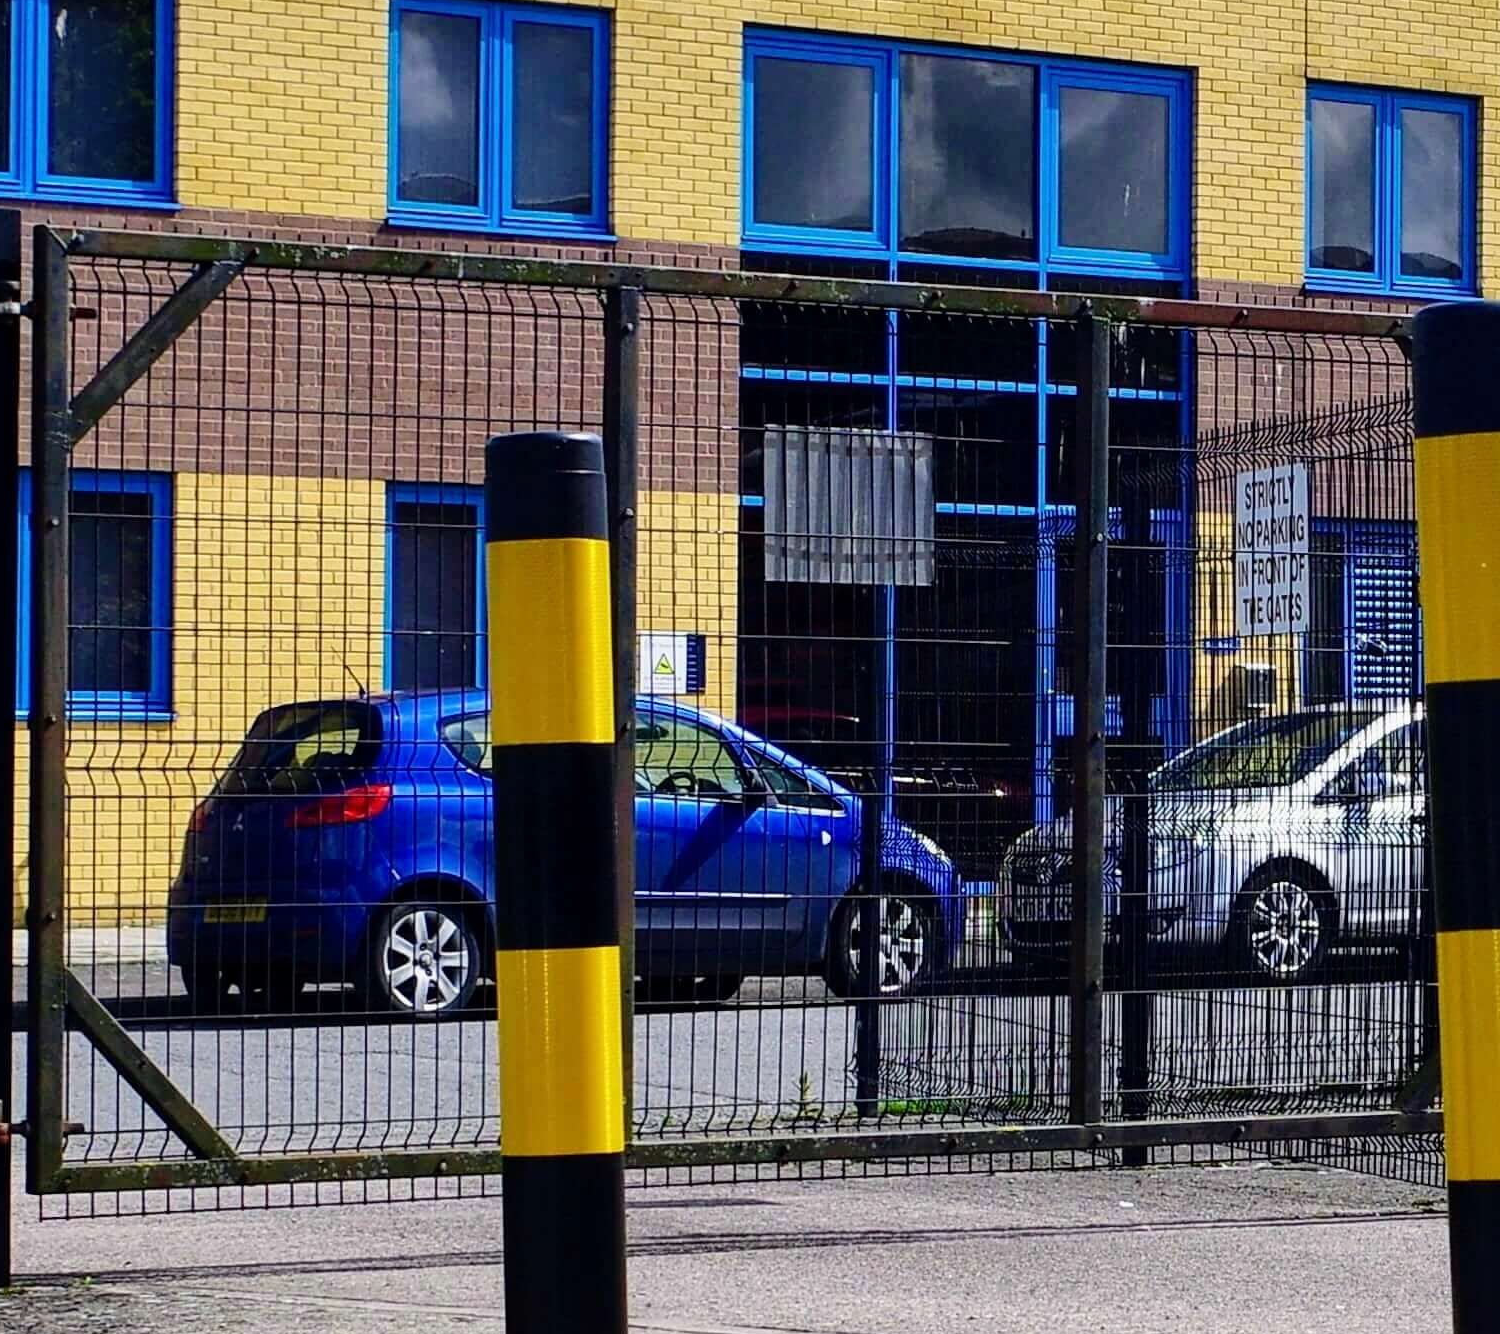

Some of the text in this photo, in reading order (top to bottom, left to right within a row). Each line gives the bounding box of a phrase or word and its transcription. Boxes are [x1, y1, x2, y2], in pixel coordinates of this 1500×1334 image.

[1244, 475, 1296, 510] STRICTLY
[1238, 514, 1305, 549] NO PARKING
[1238, 554, 1305, 588] IN FRONT OF
[1266, 592, 1302, 623] GATES
